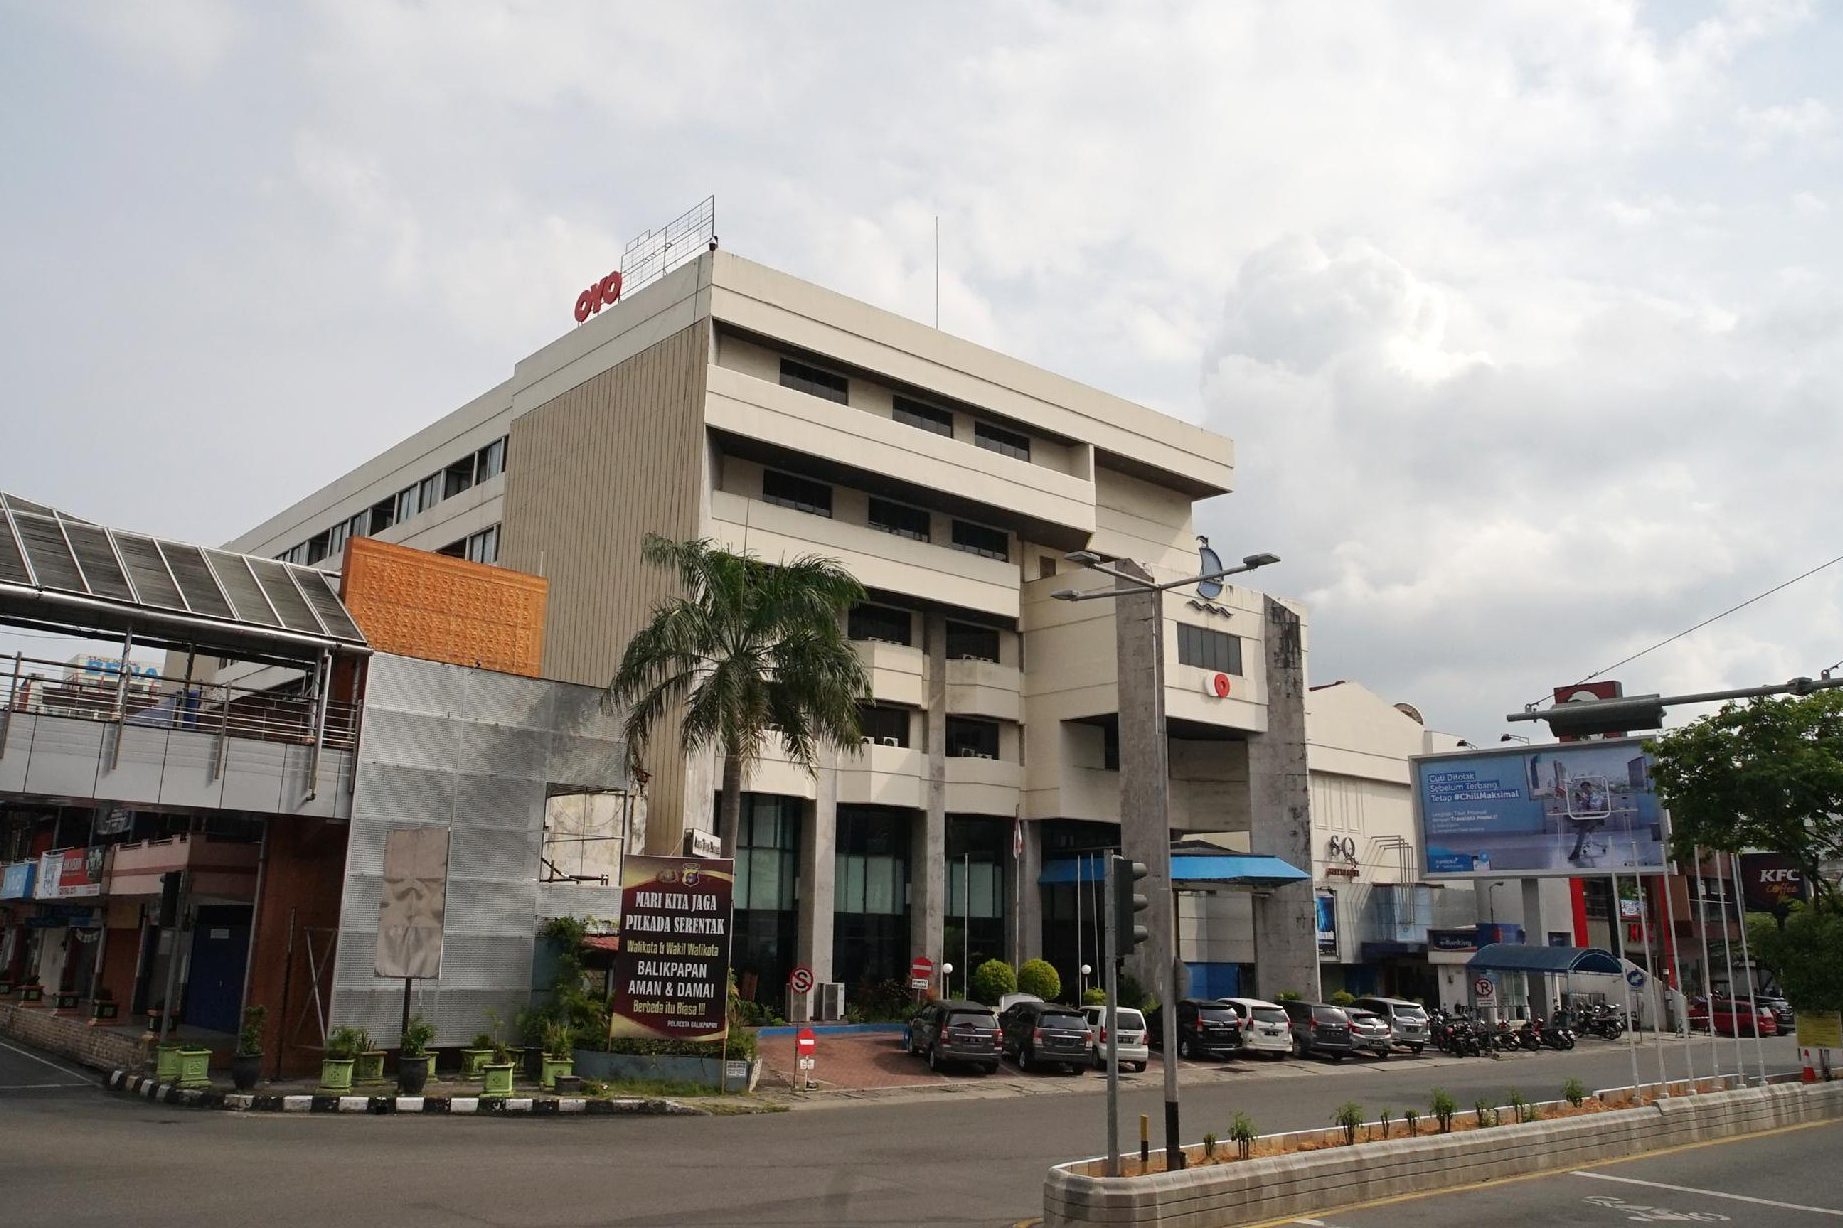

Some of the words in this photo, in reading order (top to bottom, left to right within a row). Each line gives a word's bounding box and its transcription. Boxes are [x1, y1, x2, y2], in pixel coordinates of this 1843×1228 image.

[574, 270, 623, 323] OYO
[1430, 784, 1464, 793] Sebelum
[1454, 789, 1520, 801] #ChillMaksimal
[1760, 869, 1800, 882] KFC
[635, 891, 662, 909] MARI
[664, 893, 689, 910] KITA
[691, 894, 717, 912] JAGA
[625, 914, 671, 933] PILKADA
[674, 916, 725, 935] SERENTAK
[627, 940, 658, 954] Walikota
[666, 941, 686, 955] Wakil
[687, 943, 719, 956] Walikota
[637, 960, 708, 978] BALIKPAPAN
[628, 980, 662, 996] AMAN
[665, 981, 673, 997] &
[677, 982, 715, 998] DAMAI
[633, 1000, 663, 1014] Berbeda
[664, 1001, 675, 1014] itu
[676, 1001, 698, 1015] Biasa
